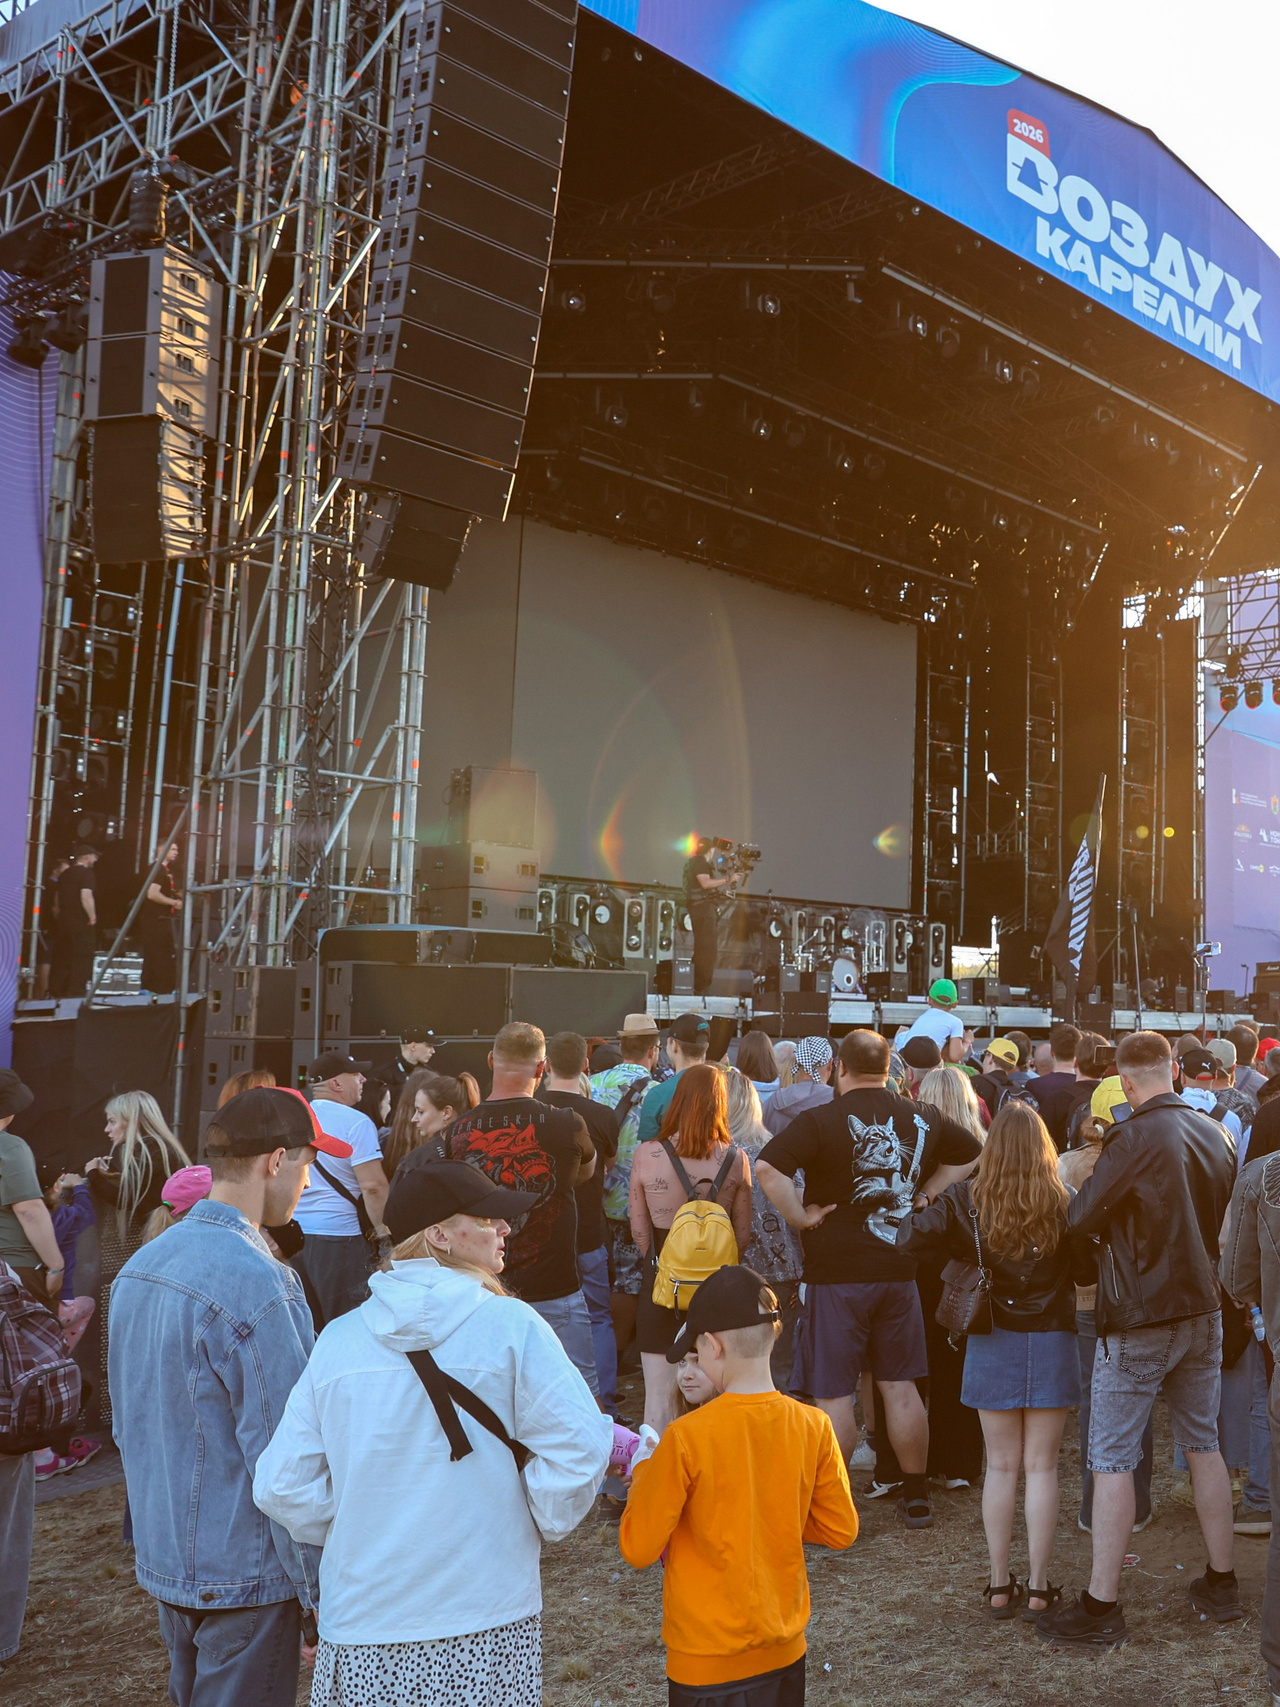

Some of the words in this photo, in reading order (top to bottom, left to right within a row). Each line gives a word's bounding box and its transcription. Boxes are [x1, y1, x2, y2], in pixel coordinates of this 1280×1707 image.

[1012, 118, 1044, 144] 2026
[1007, 132, 1263, 345] ВОЗДУХ
[1036, 216, 1241, 370] КАРЕЛИИ
[503, 1113, 546, 1127] SKIN
